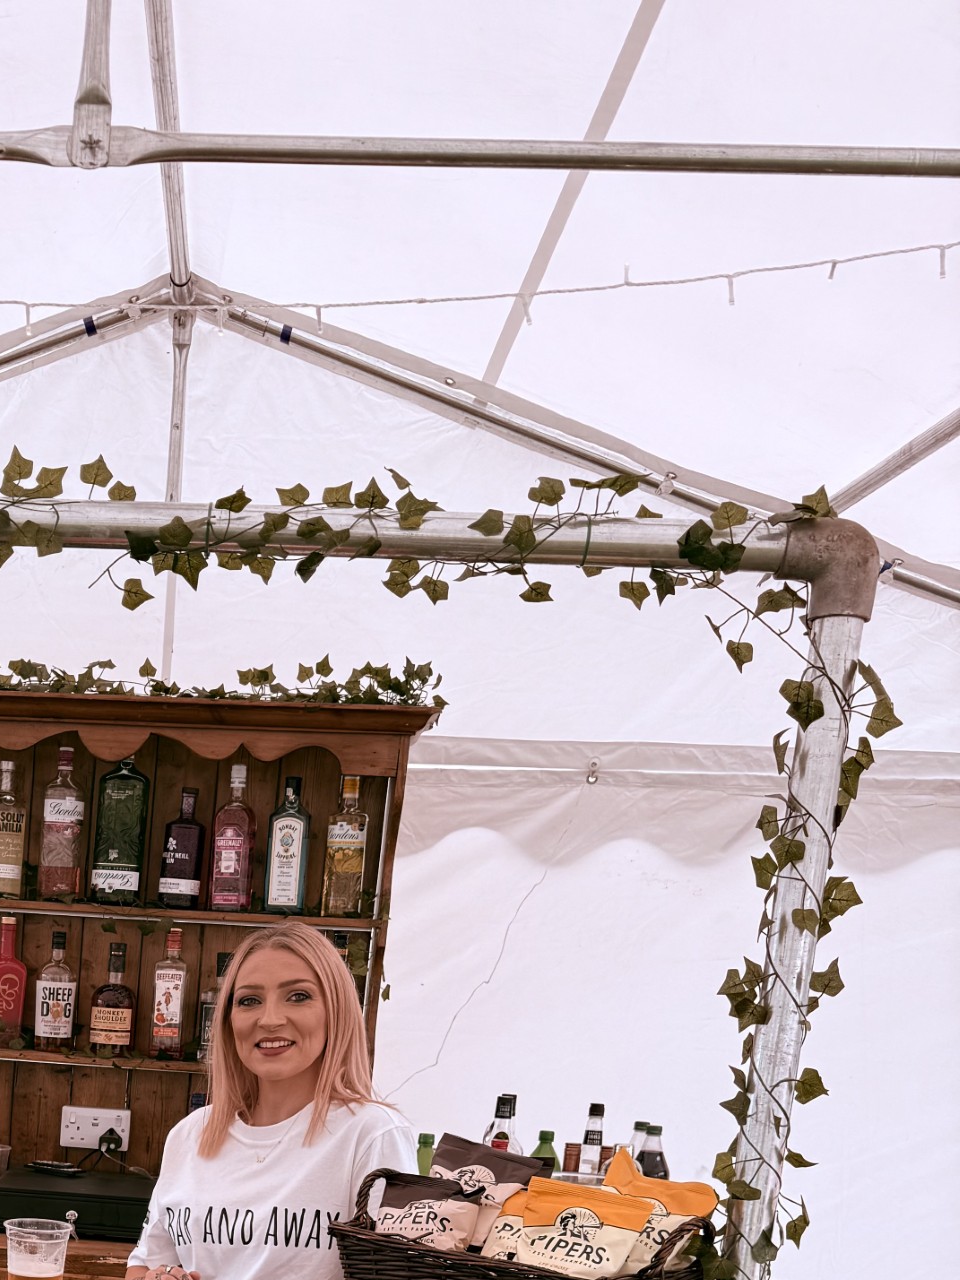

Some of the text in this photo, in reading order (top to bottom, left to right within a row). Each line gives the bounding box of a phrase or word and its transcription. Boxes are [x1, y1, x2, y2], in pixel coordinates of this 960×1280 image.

[278, 823, 298, 833] BOMBAY
[156, 973, 182, 982] BEEFEATER
[42, 986, 73, 1003] SHEEP
[96, 1008, 125, 1017] MONKEY
[166, 1206, 192, 1246] BAR
[264, 1206, 341, 1250] AWAY
[380, 1210, 451, 1233] PIPERS
[529, 1234, 607, 1265] PIPERS
